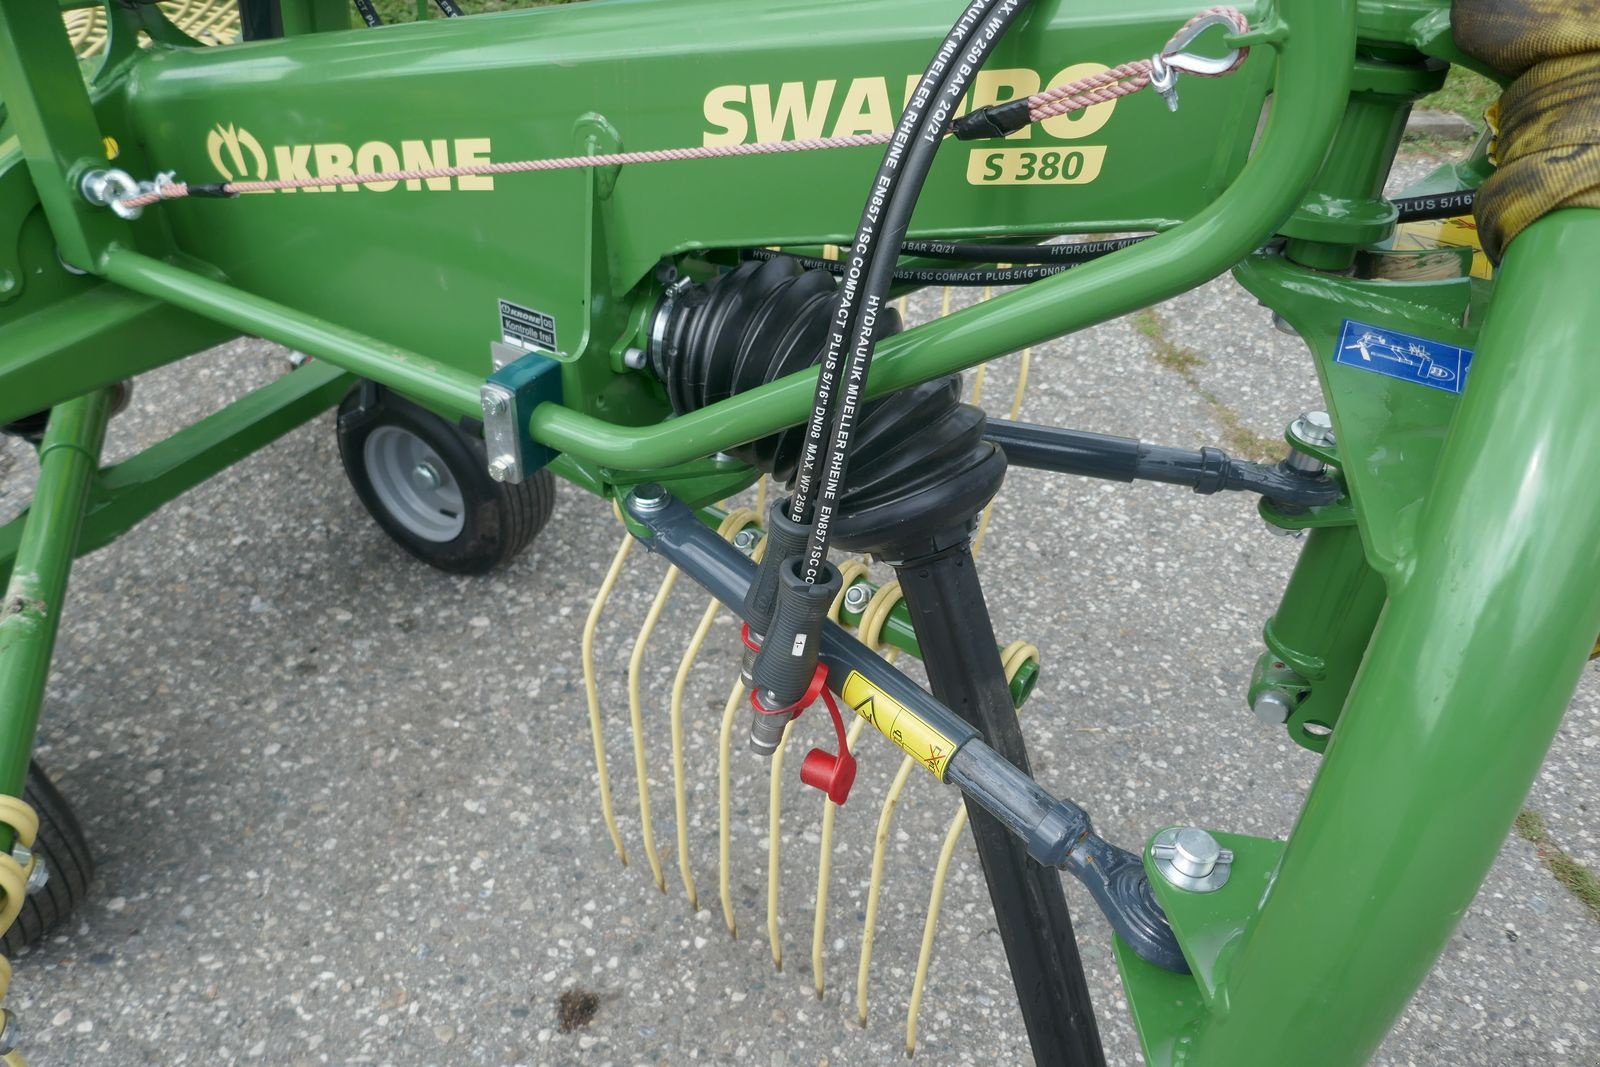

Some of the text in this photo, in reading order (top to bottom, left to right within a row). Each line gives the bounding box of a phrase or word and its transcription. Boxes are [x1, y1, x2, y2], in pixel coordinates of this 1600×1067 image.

[985, 17, 1003, 40] WP
[966, 38, 987, 64] 250
[912, 39, 957, 109] MUELLER
[947, 64, 972, 96] BAR
[924, 100, 951, 143] 2Q/21
[886, 110, 918, 169] RHEINE
[273, 138, 494, 193] KRONE
[983, 149, 1084, 181] S 380
[866, 175, 891, 223] EN857
[856, 226, 873, 255] 1SC
[908, 242, 927, 252] BAR
[930, 244, 956, 254] 2Q/21
[1051, 241, 1114, 255] HYDRAULIK
[916, 272, 933, 280] 1SC
[936, 272, 982, 281] COMPACT
[986, 271, 1011, 280] PLUS
[1013, 269, 1038, 280] 5/16"
[836, 256, 864, 329] COMPACT
[505, 319, 538, 339] Kontrolle
[539, 331, 552, 344] frei
[511, 308, 541, 325] KRONE
[826, 332, 843, 370] PLUS
[850, 295, 880, 381] HYDRAULIK
[819, 371, 833, 405] 5/16"
[810, 406, 826, 439] DN08
[835, 384, 859, 449] MUELLER
[803, 442, 818, 472] MAX.
[800, 475, 811, 493] WP
[825, 451, 844, 500] RHEINE
[794, 493, 806, 513] 250
[815, 505, 832, 543] EN857
[809, 545, 823, 567] 1SC
